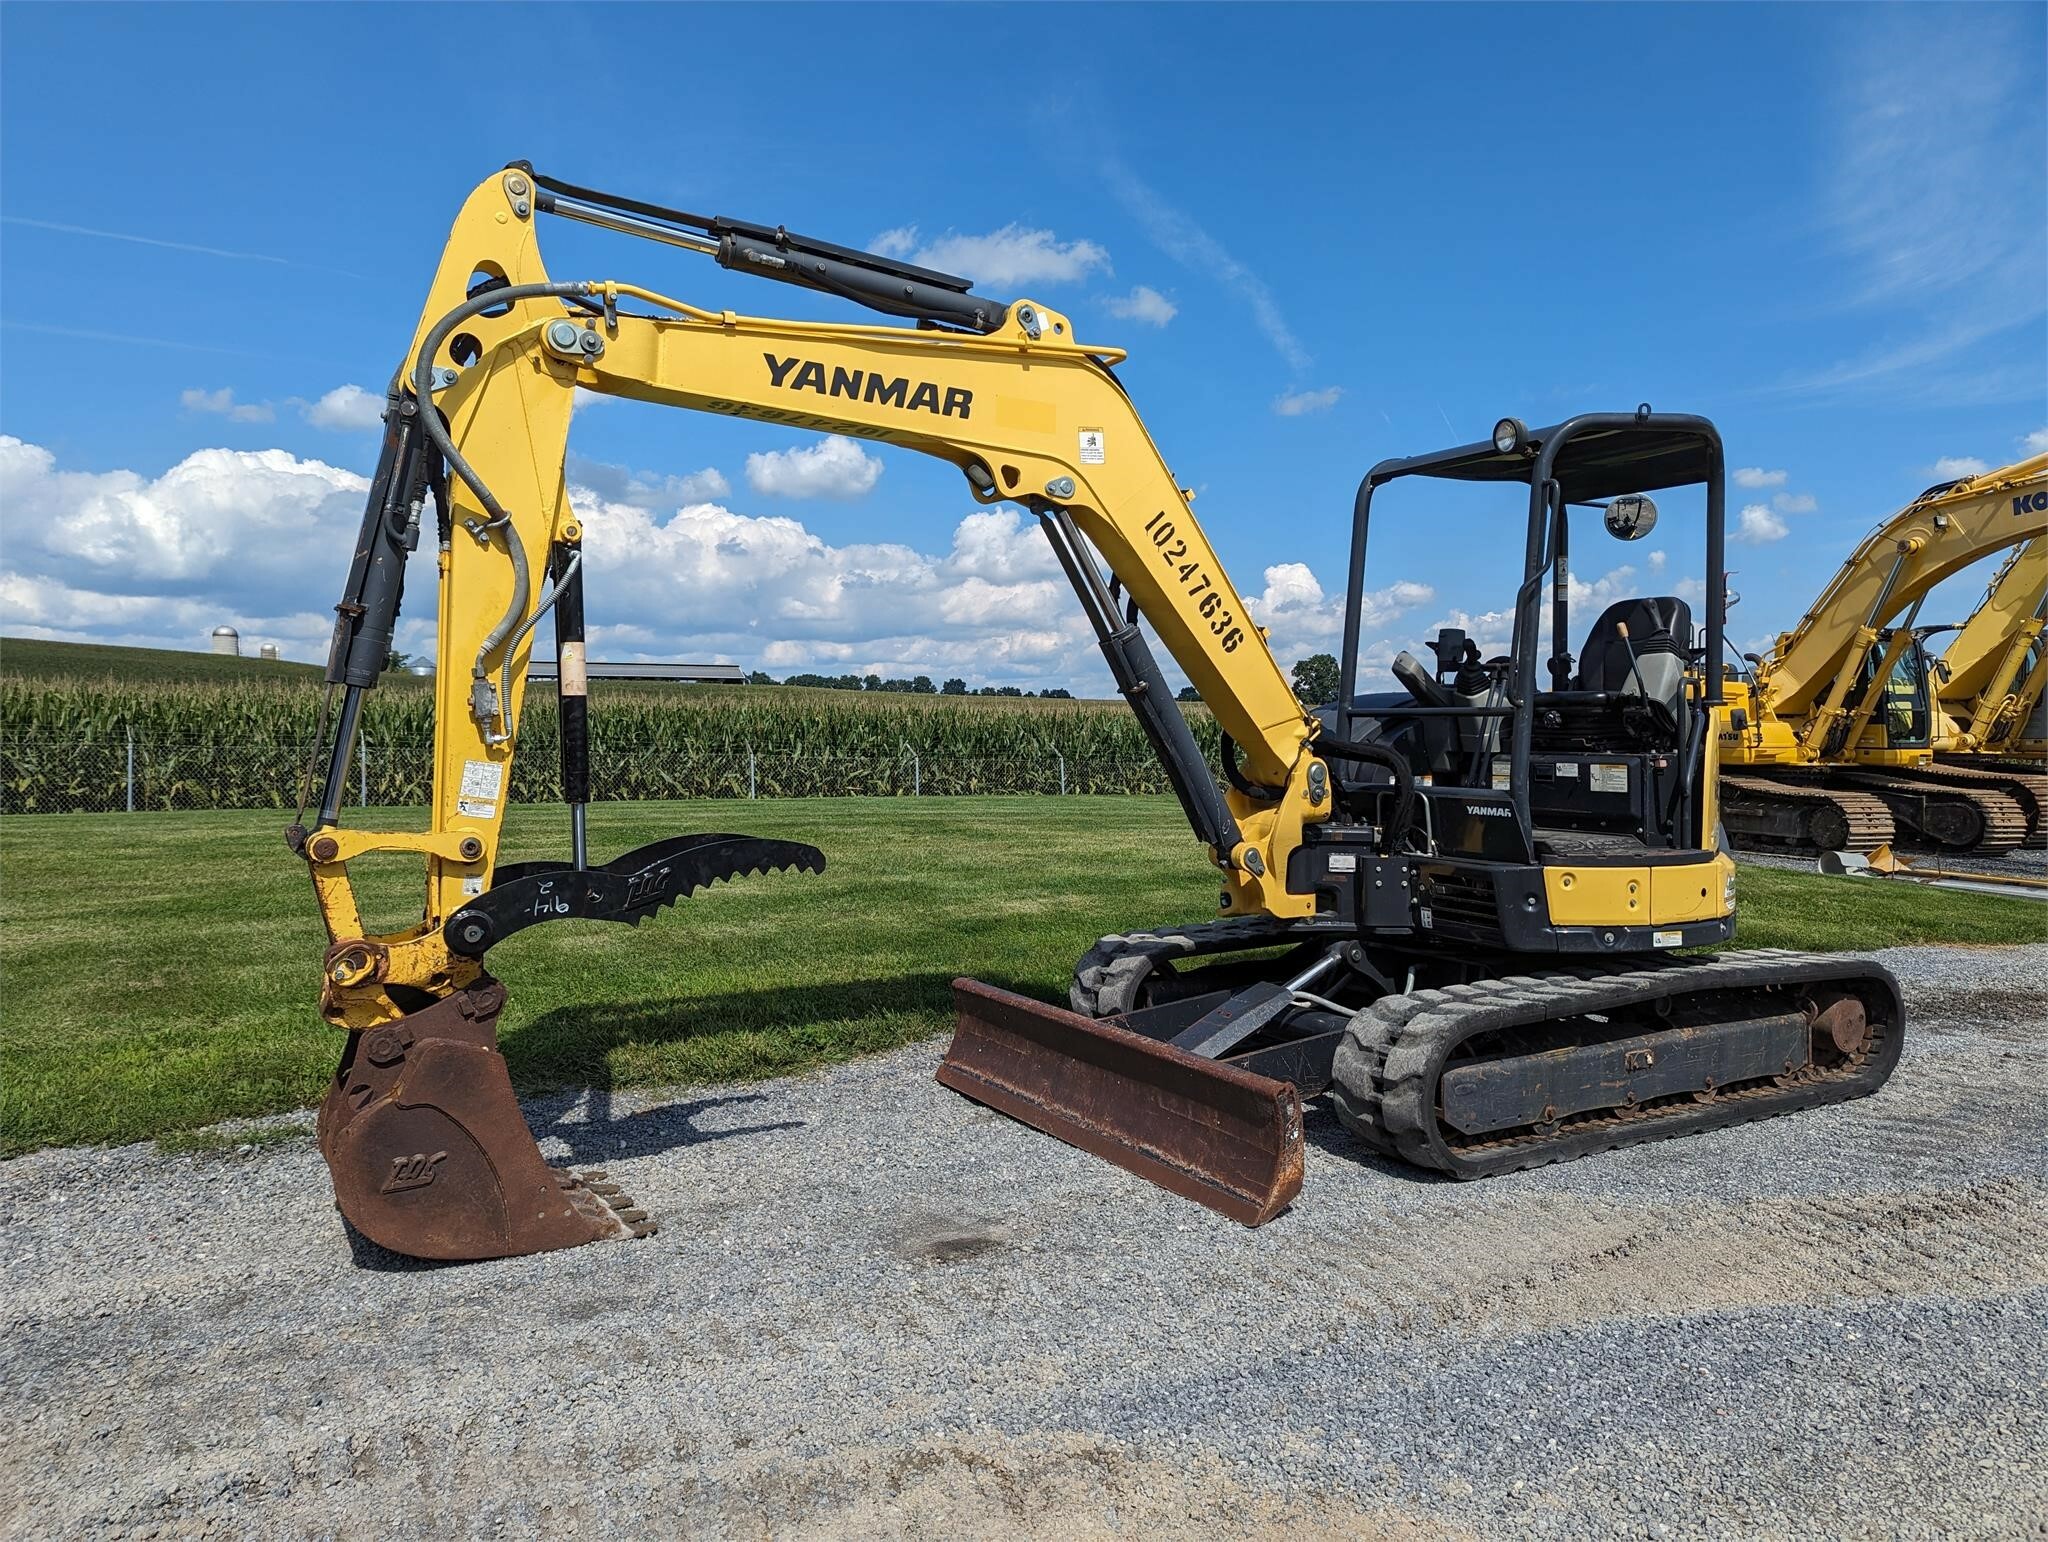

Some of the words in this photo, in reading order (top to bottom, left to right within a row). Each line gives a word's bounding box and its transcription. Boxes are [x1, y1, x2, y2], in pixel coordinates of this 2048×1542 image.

[763, 353, 974, 420] YANMAR
[2013, 491, 2048, 516] KO
[1144, 510, 1244, 653] 10247636
[1466, 805, 1511, 818] YANMAR
